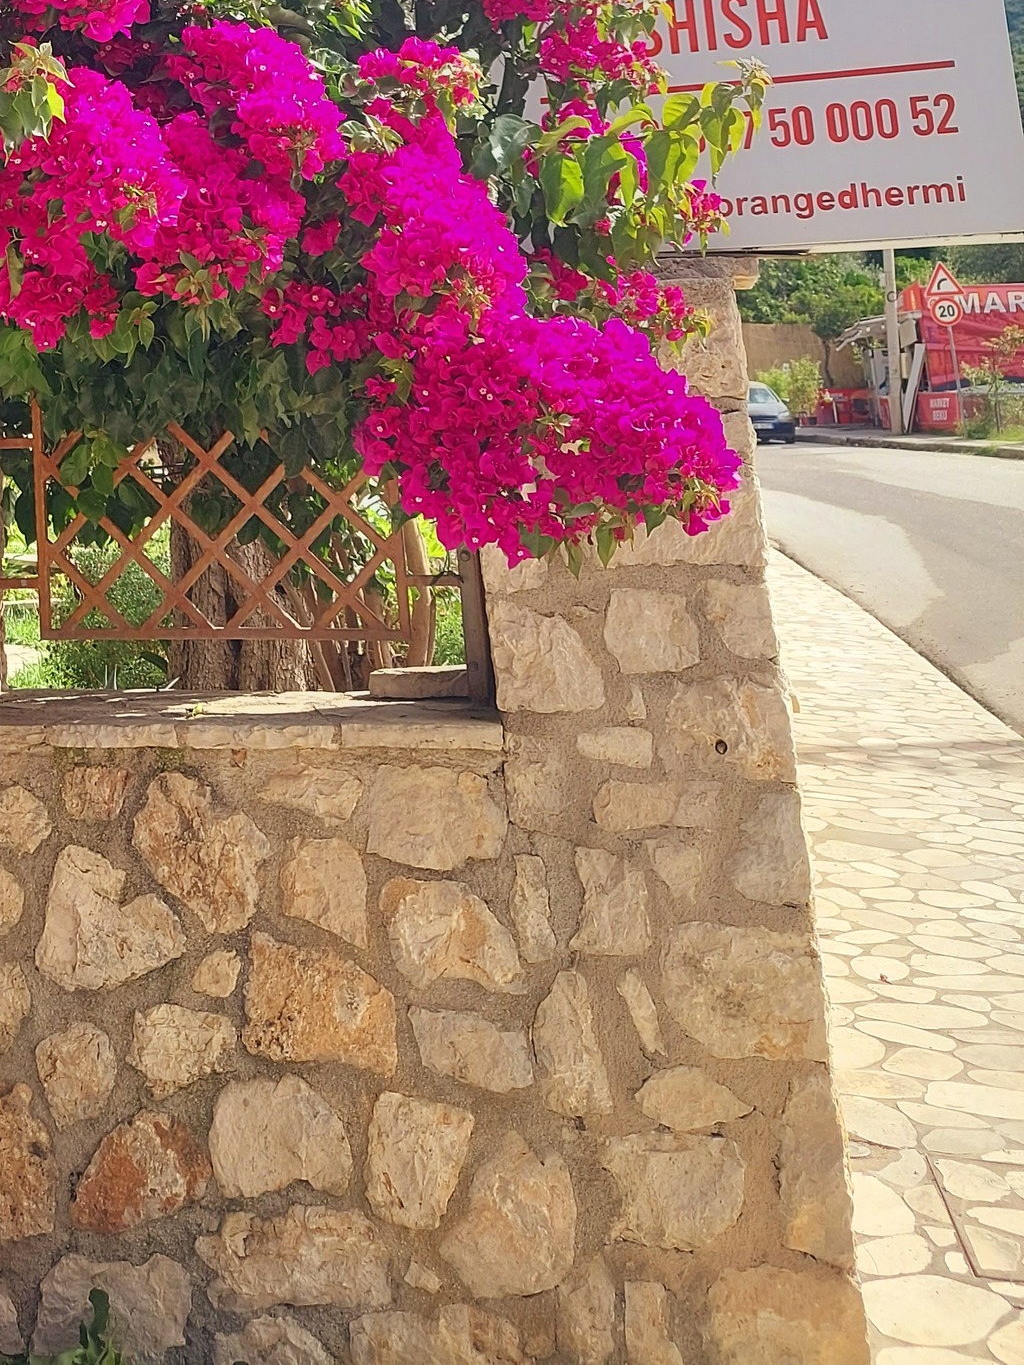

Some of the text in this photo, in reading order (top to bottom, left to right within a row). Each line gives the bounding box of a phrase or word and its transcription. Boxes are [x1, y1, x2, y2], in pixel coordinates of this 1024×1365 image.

[768, 105, 814, 148] 50
[826, 98, 900, 143] 000
[909, 93, 960, 136] 52
[938, 304, 955, 318] 20
